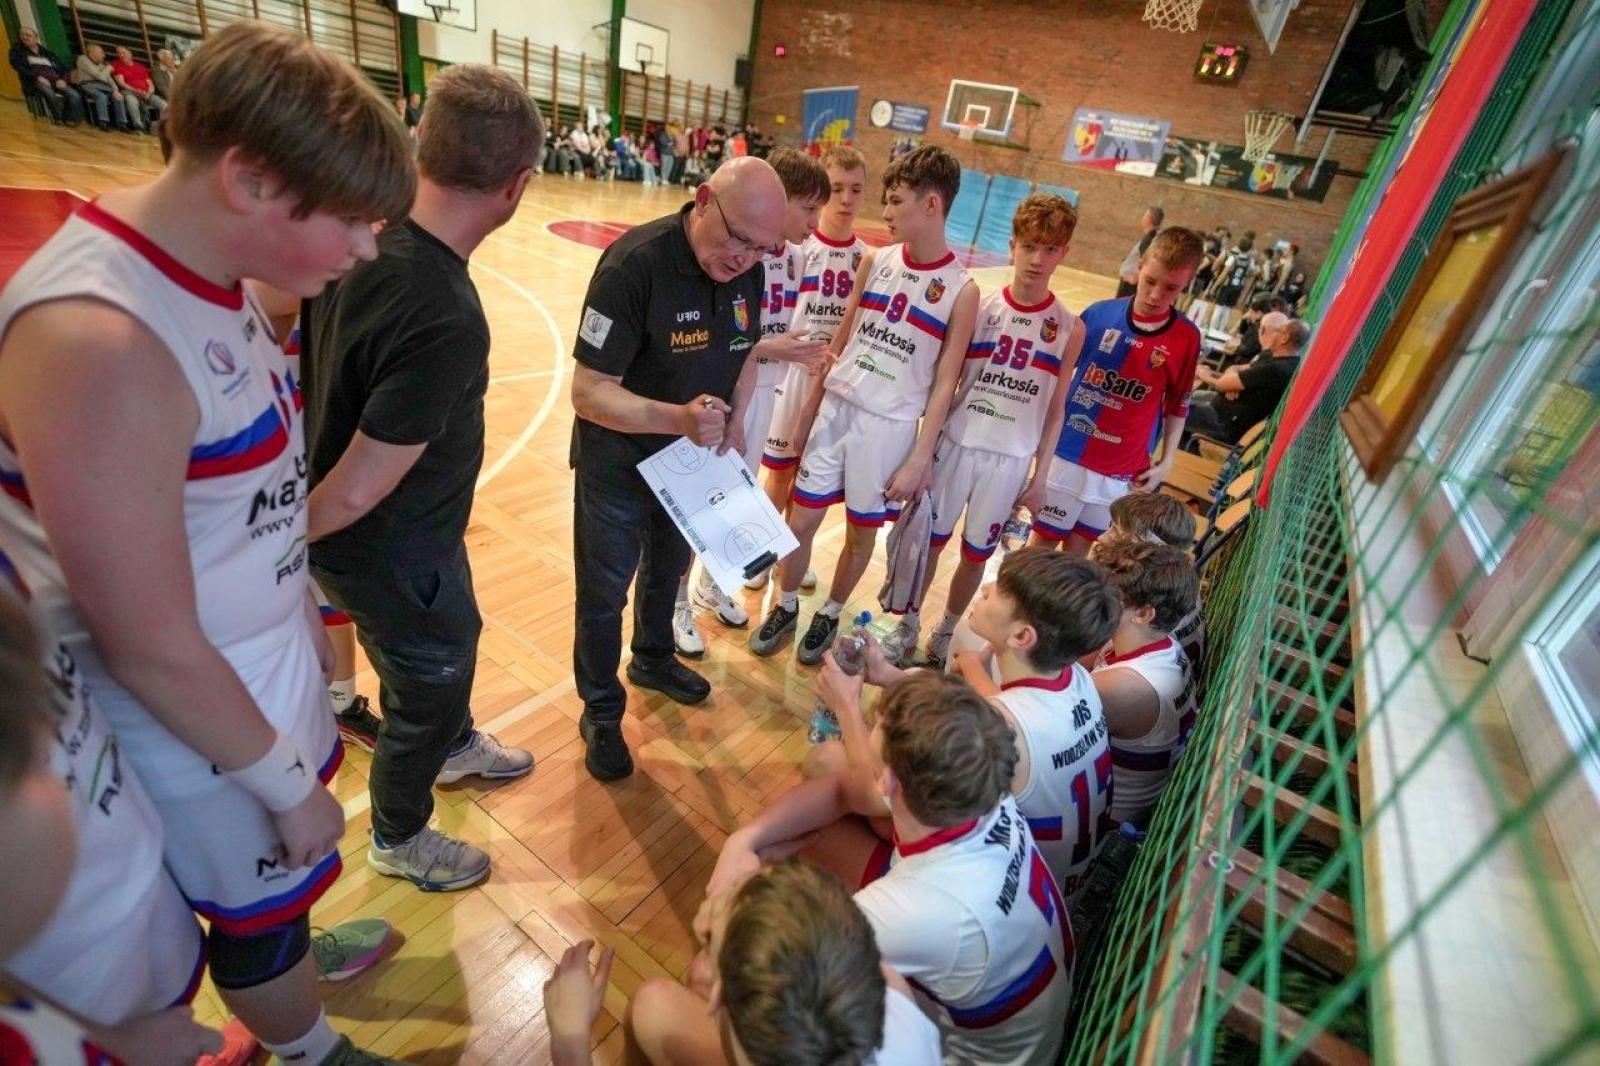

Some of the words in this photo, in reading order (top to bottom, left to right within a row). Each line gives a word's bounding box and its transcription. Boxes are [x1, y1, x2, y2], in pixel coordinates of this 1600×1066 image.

[770, 283, 783, 315] 5
[821, 269, 851, 299] 99
[886, 293, 908, 324] 9
[991, 334, 1033, 371] 35
